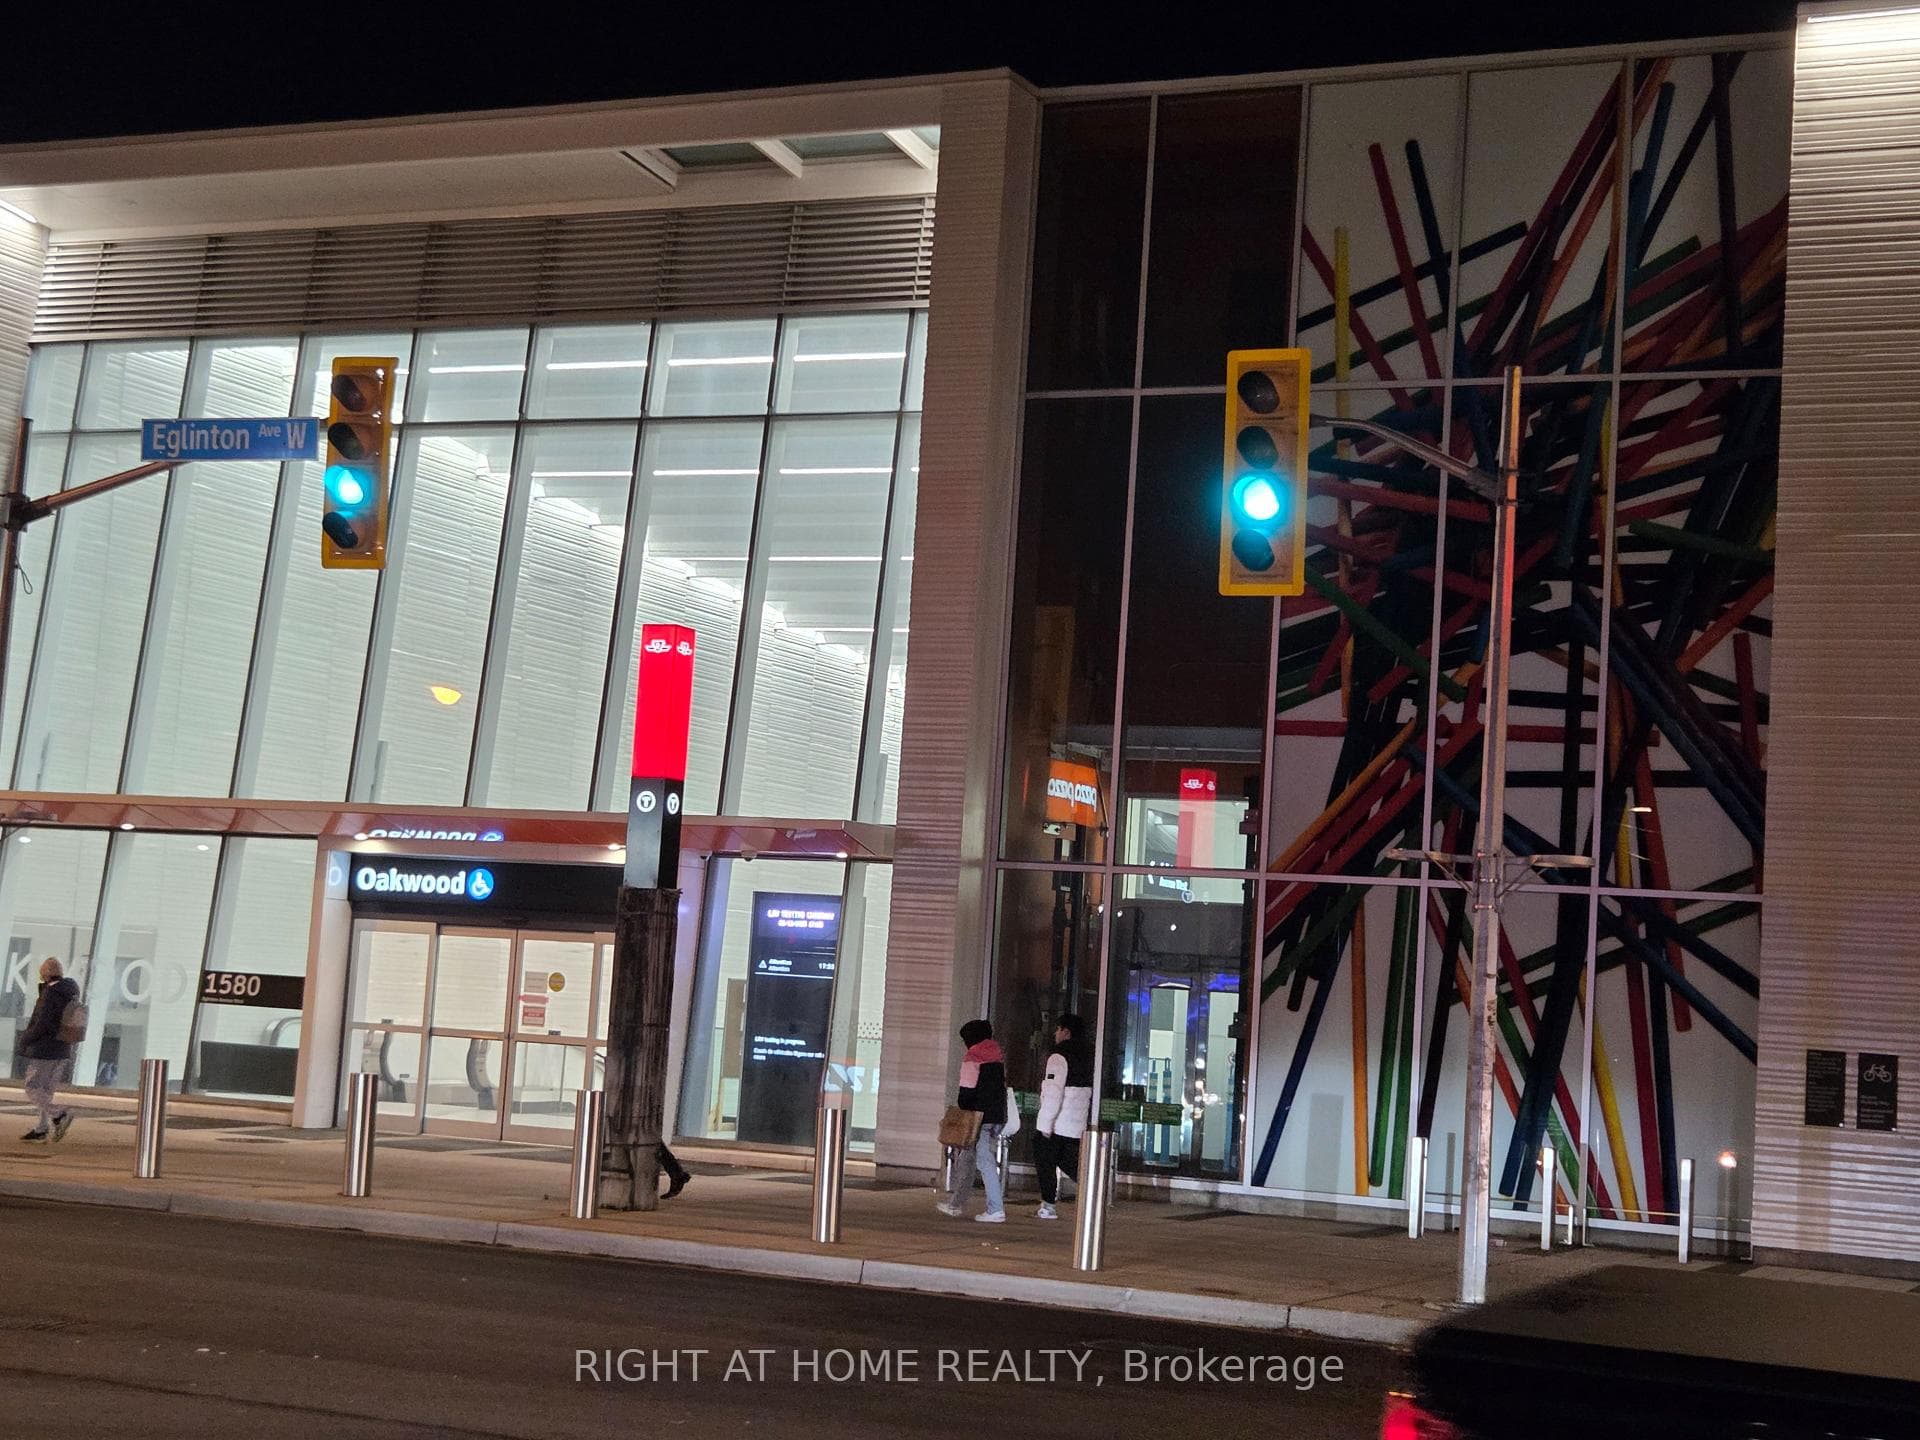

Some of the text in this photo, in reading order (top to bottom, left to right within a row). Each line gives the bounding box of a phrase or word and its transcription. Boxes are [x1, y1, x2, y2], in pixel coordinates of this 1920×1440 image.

[153, 422, 307, 458] Eglinton Ave W
[356, 867, 467, 895] Oakwood
[205, 973, 261, 996] 1580
